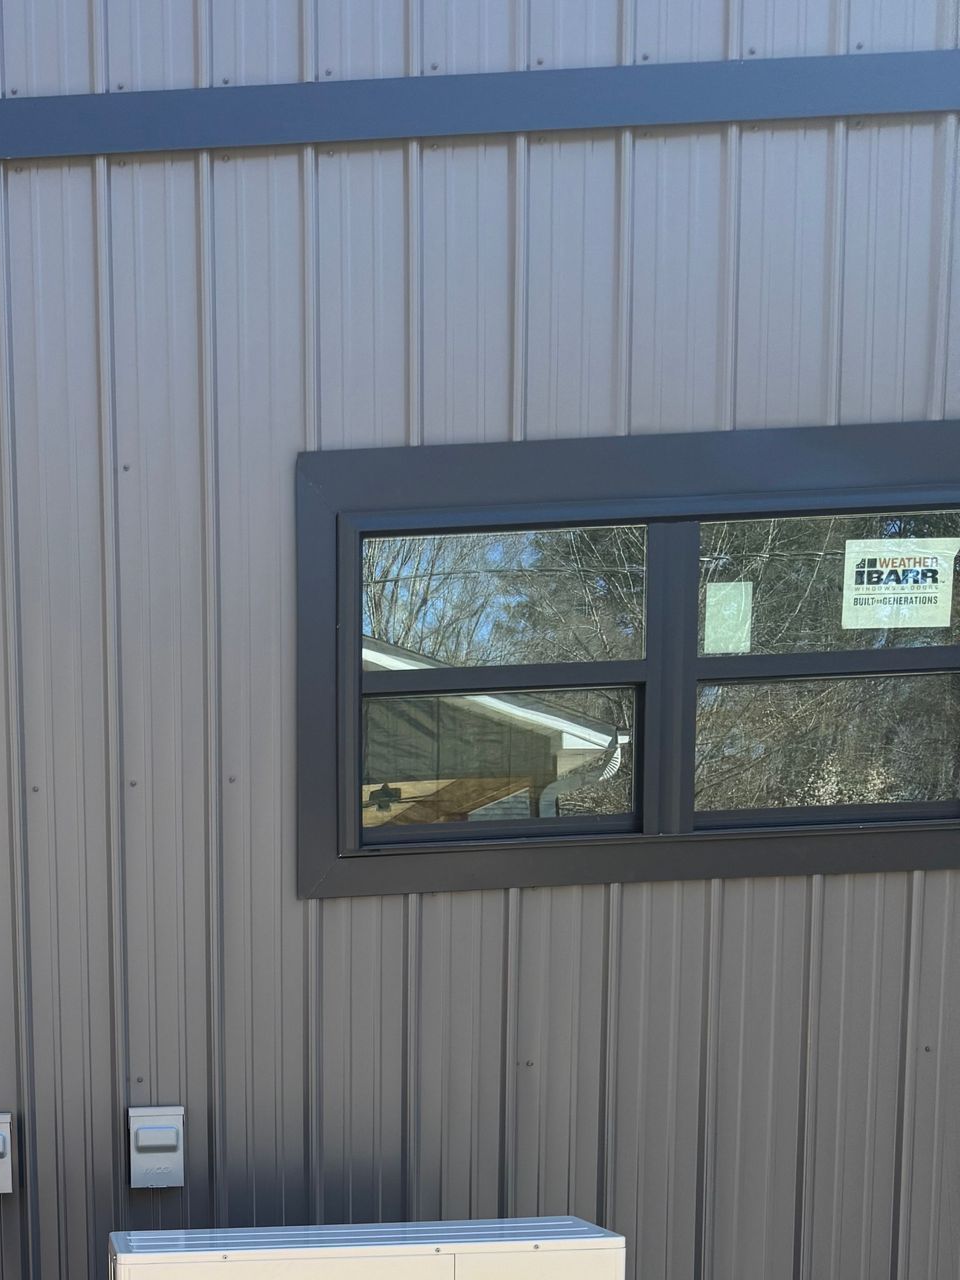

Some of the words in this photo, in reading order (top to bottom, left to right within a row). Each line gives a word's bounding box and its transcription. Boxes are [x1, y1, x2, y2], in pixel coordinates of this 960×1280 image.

[879, 557, 939, 568] WEATHER
[853, 597, 874, 606] BUILT
[882, 596, 938, 605] GENERATIONS
